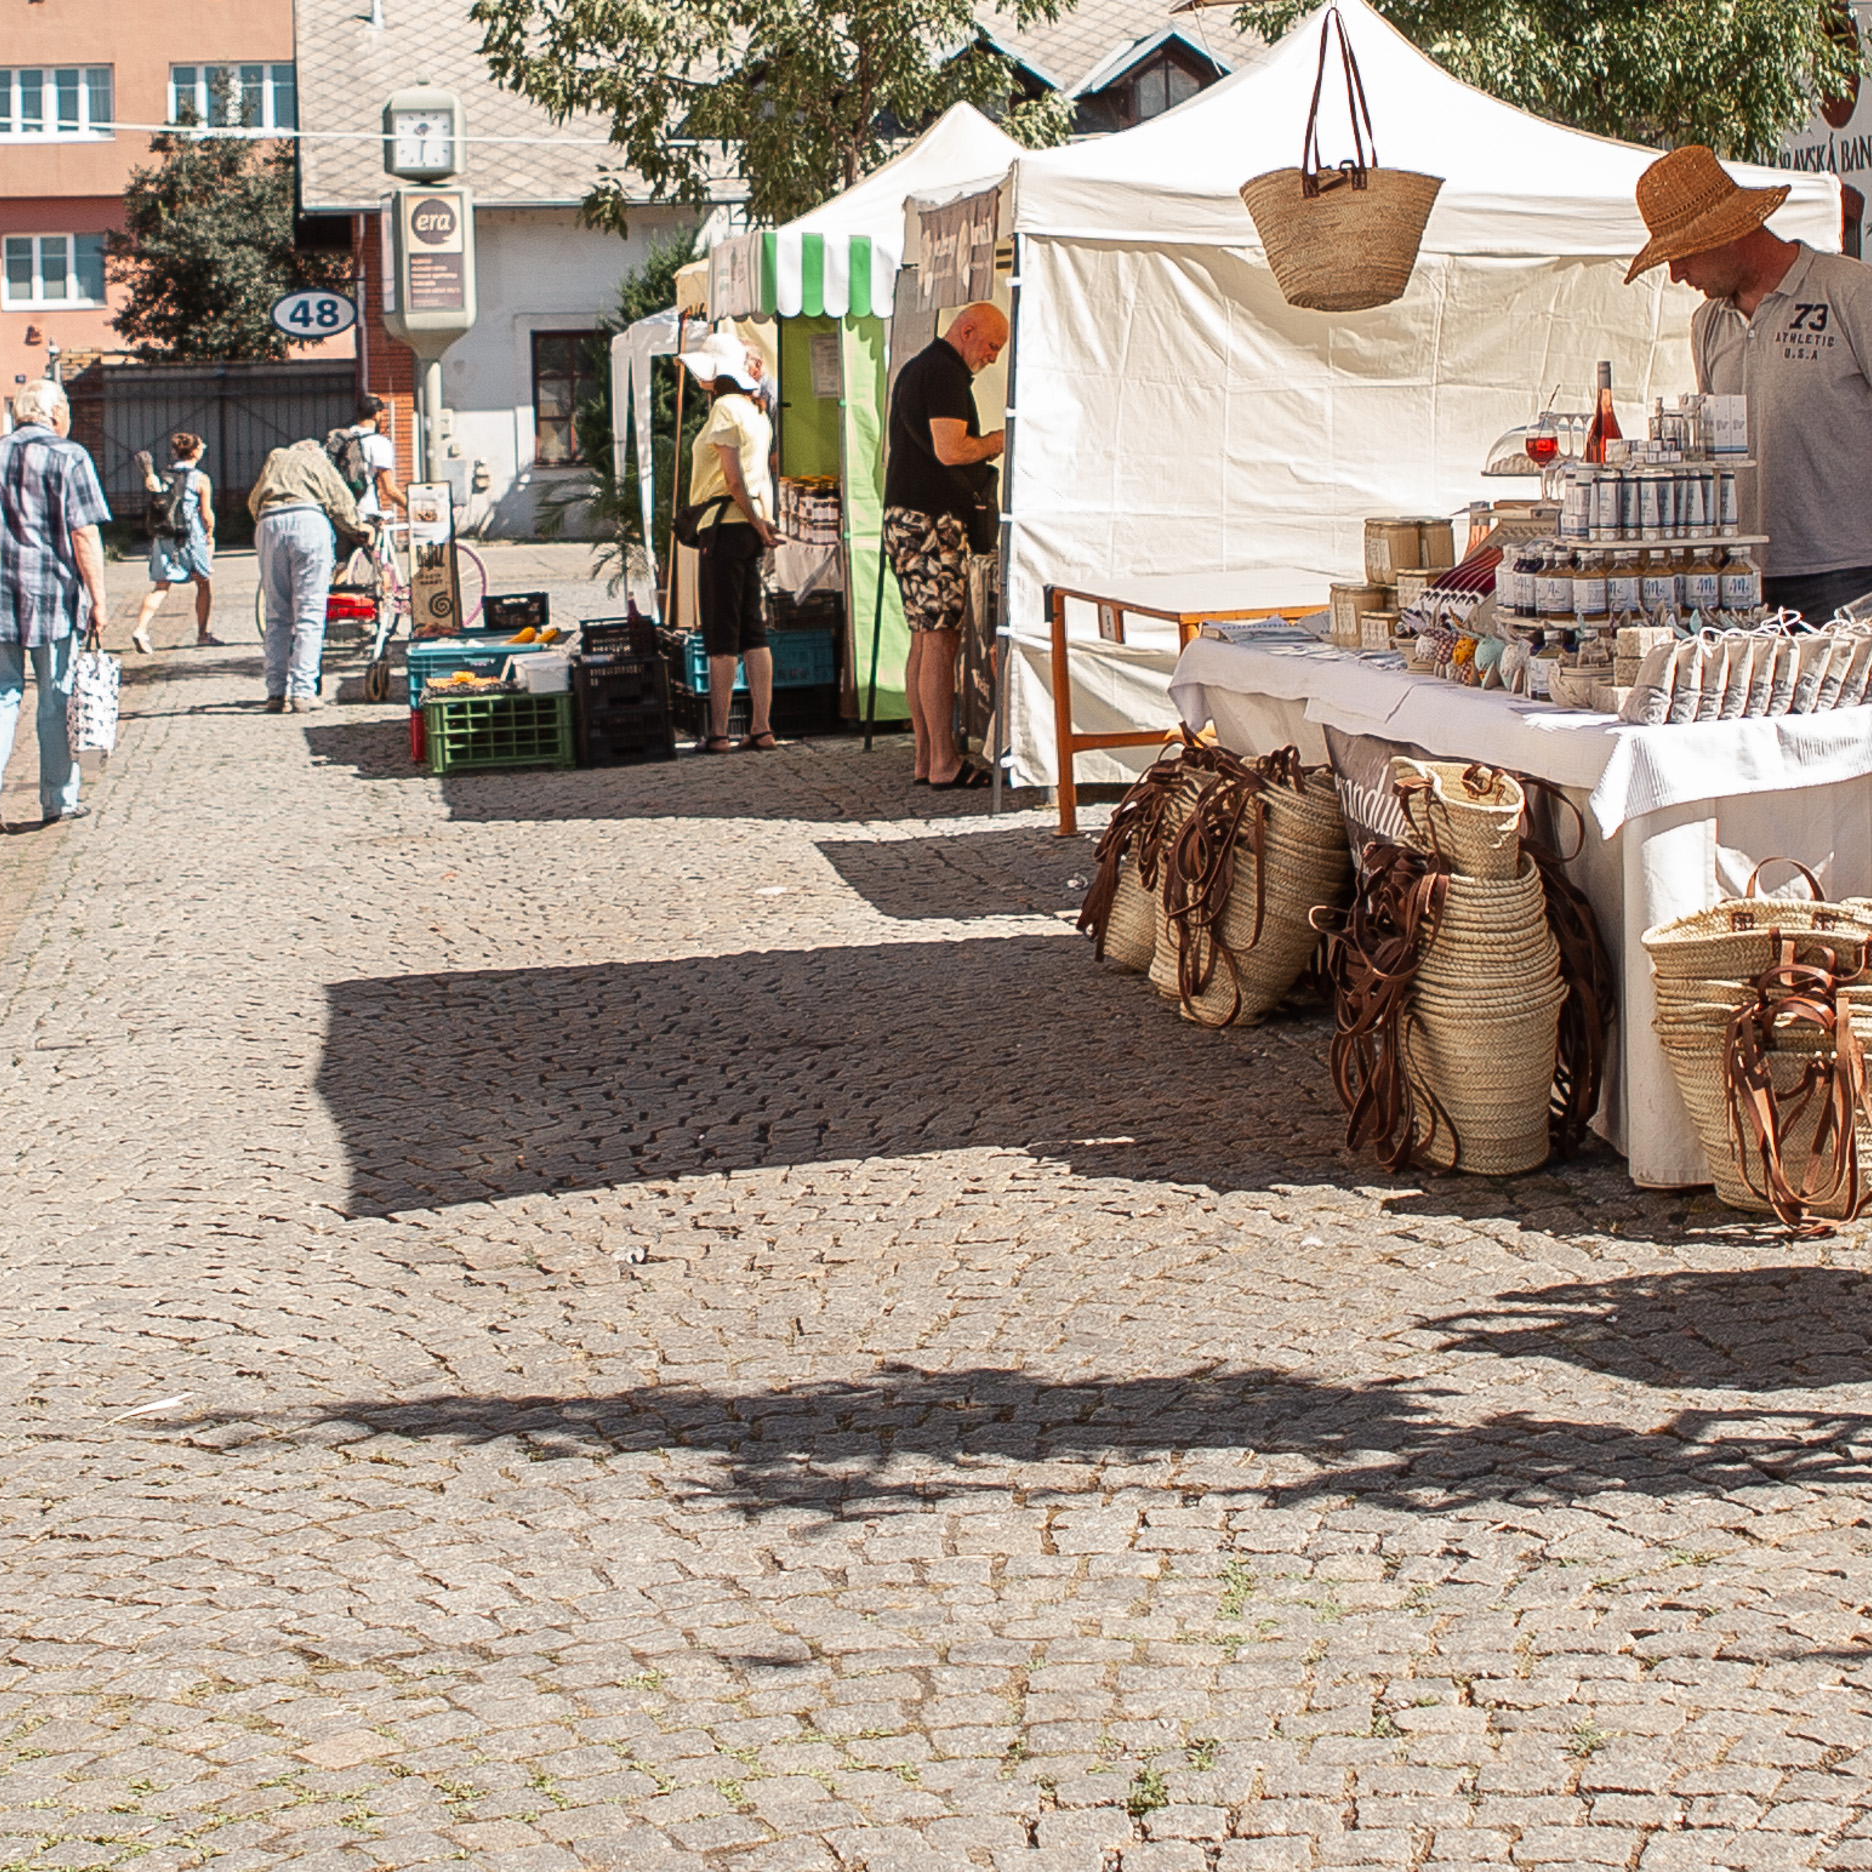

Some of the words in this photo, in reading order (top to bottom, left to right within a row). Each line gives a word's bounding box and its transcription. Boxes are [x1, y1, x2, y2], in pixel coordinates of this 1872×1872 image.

[416, 212, 451, 232] era
[289, 299, 340, 328] 48
[1789, 303, 1830, 332] 73
[1774, 331, 1836, 348] ATHLETIC
